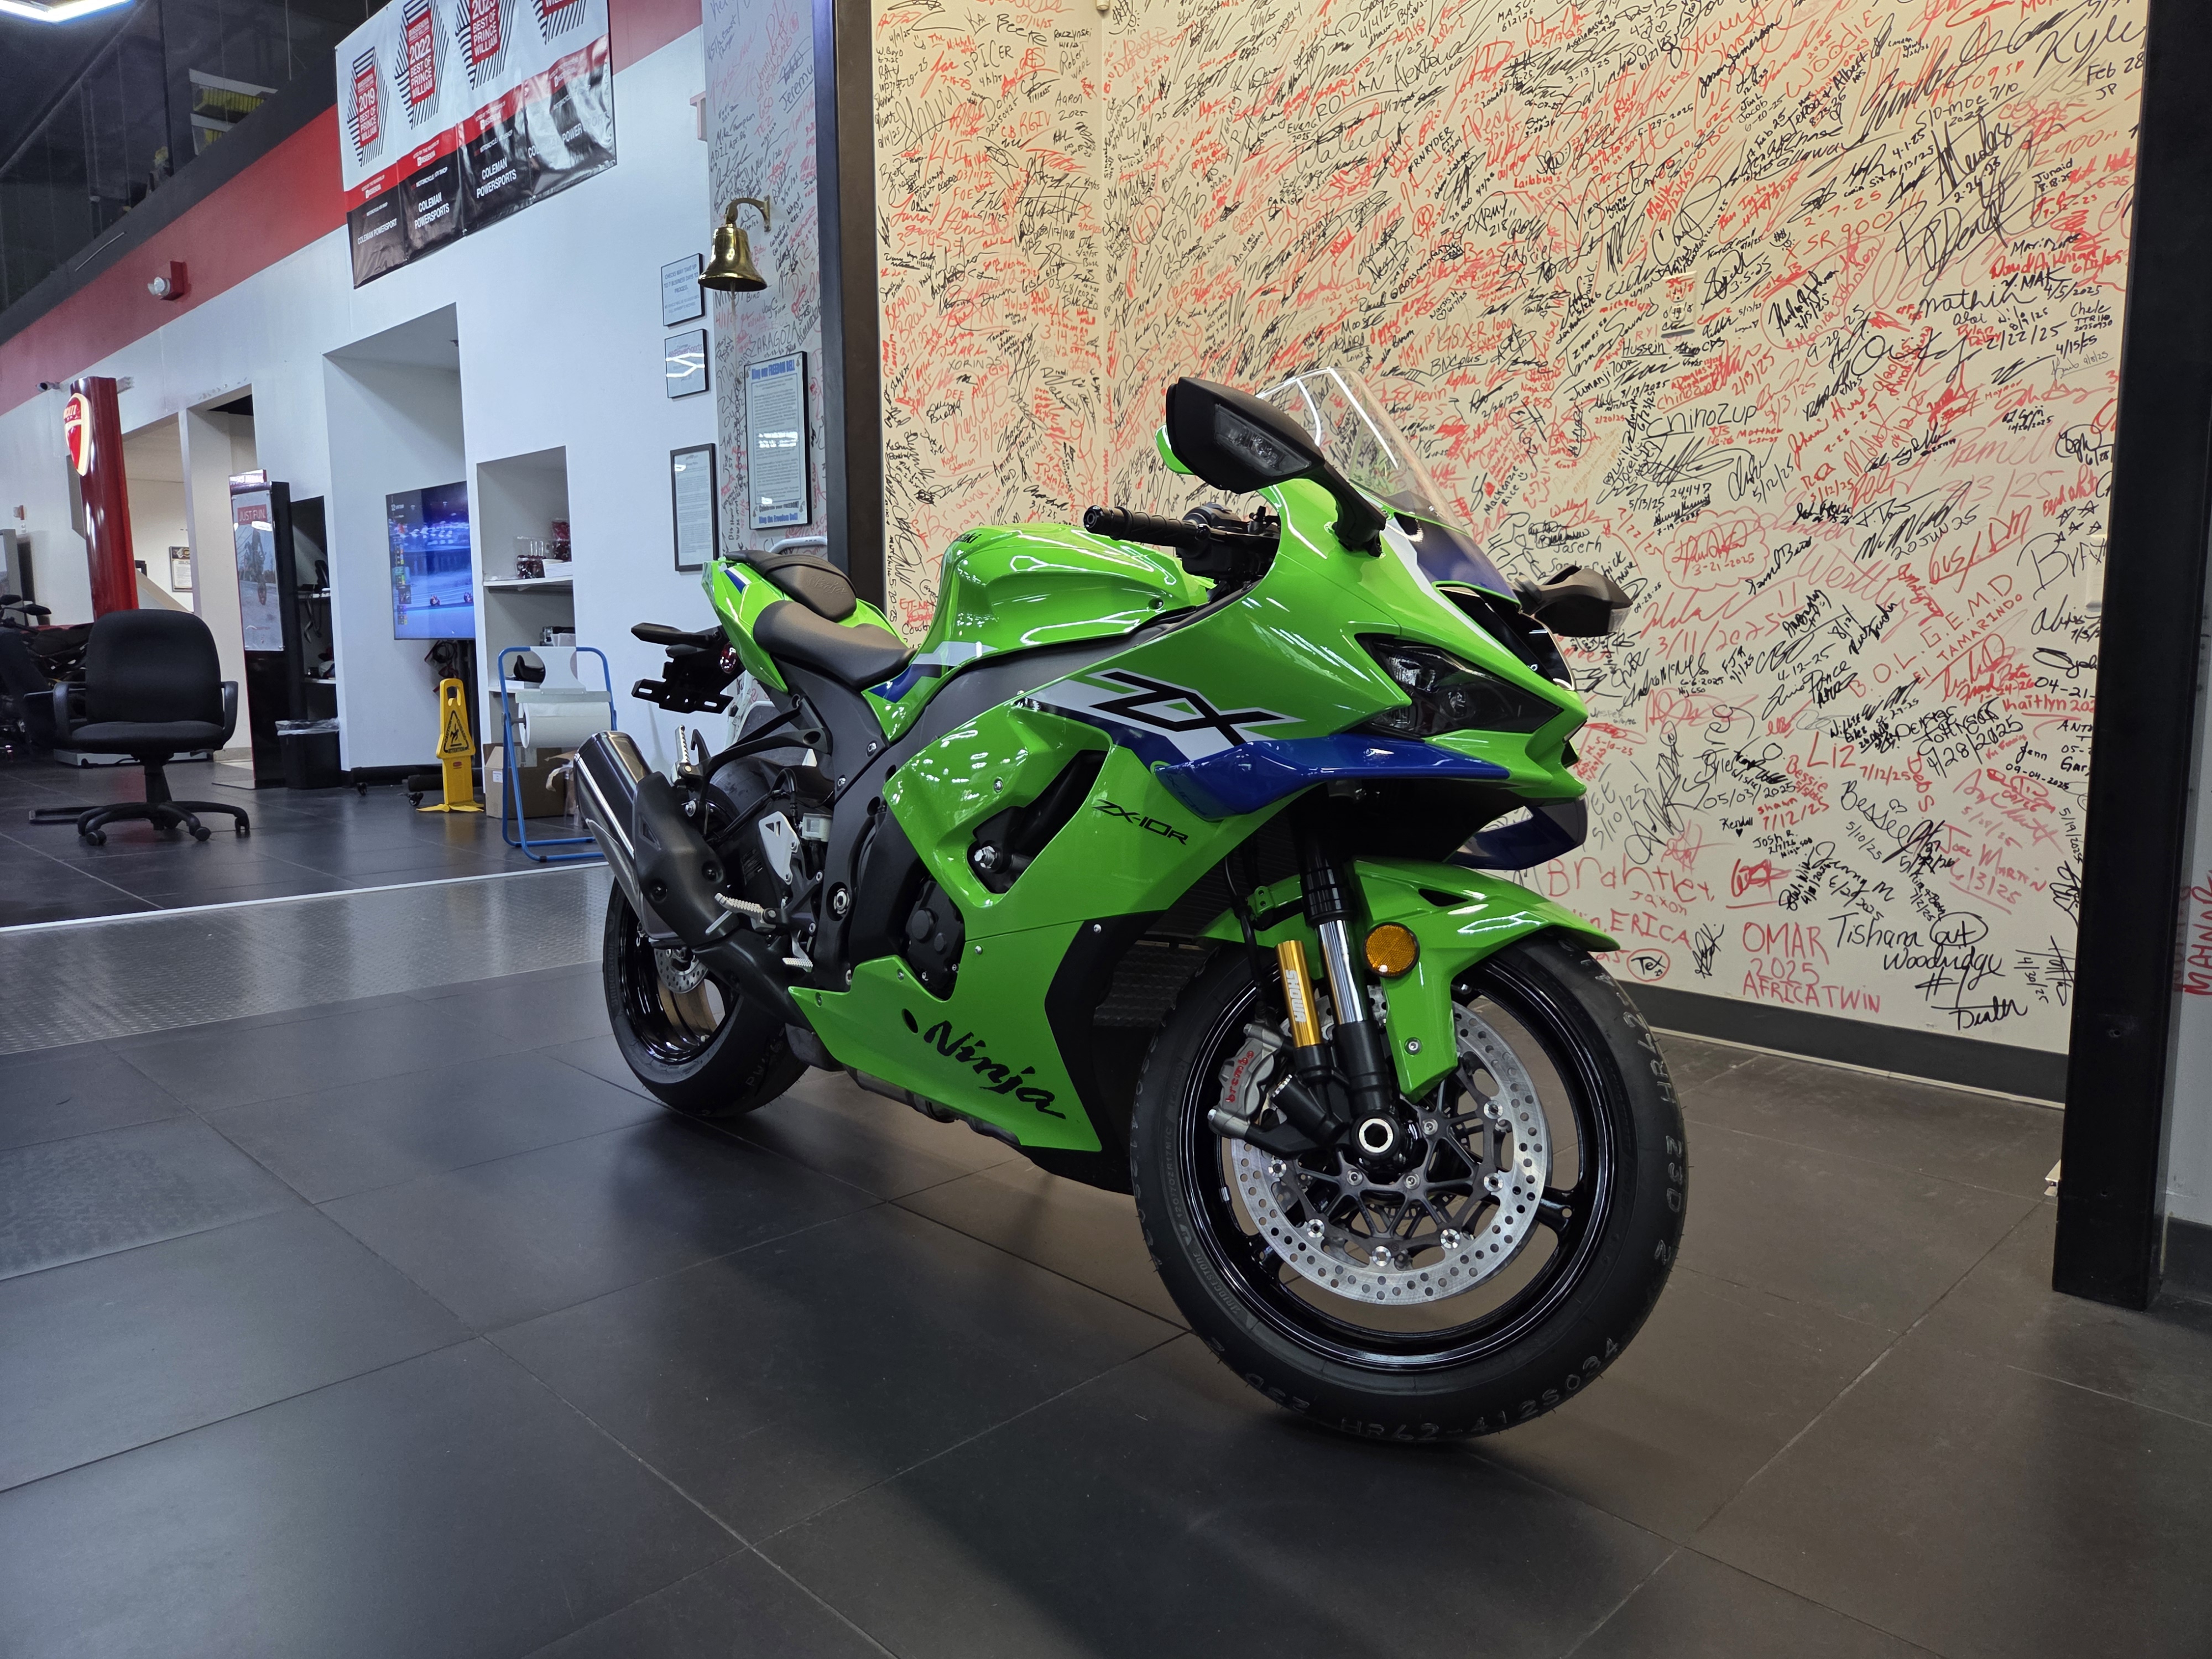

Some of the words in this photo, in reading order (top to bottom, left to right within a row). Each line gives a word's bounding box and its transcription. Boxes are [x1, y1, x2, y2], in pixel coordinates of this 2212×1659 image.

[473, 15, 488, 34] BEST
[488, 9, 496, 22] OF
[473, 22, 497, 46] PRINCE
[474, 34, 498, 56] WILLIAM
[410, 34, 431, 65] 2022
[410, 61, 424, 77] BEST
[424, 55, 431, 67] OF
[411, 67, 432, 89] PRINCE
[2087, 63, 2116, 86] Feb
[359, 87, 375, 112] 2019
[412, 78, 432, 98] WILLIAM
[1316, 76, 1384, 118] ROMAN
[360, 109, 369, 123] BEST
[370, 105, 376, 115] OF
[361, 115, 377, 133] PRINCE
[361, 124, 377, 142] WILLIAM
[482, 157, 508, 180] COLEMAN
[477, 169, 517, 199] POWERSPORTS
[419, 192, 442, 212] COLEMAN
[415, 203, 450, 229] POWERSPORTS
[1489, 218, 1508, 237] 218
[357, 229, 374, 244] COLEMAN
[374, 218, 397, 237] POWERSPORT
[750, 320, 797, 358] ZARAGOZA
[1622, 340, 1667, 357] Hussein
[945, 389, 965, 401] DEE
[1412, 385, 1447, 403] Kevin
[1484, 466, 1519, 515] Mackenzie
[1501, 484, 1519, 507] Rice
[239, 510, 252, 521] JUST
[1937, 593, 2023, 662] TAMARINDO
[457, 719, 467, 740] CUIDADO
[1092, 799, 1188, 845] ZX-10R
[1719, 816, 1754, 831] Kendall
[1610, 907, 1692, 951] ERICA
[1743, 922, 1830, 965] OMAR
[1750, 957, 1820, 986] 2025
[1285, 969, 1307, 1022] SHOWA
[924, 1020, 1066, 1120] Ninja
[1225, 1050, 1254, 1103] brembo
[1192, 1247, 1241, 1314] BRIDGESTONE
